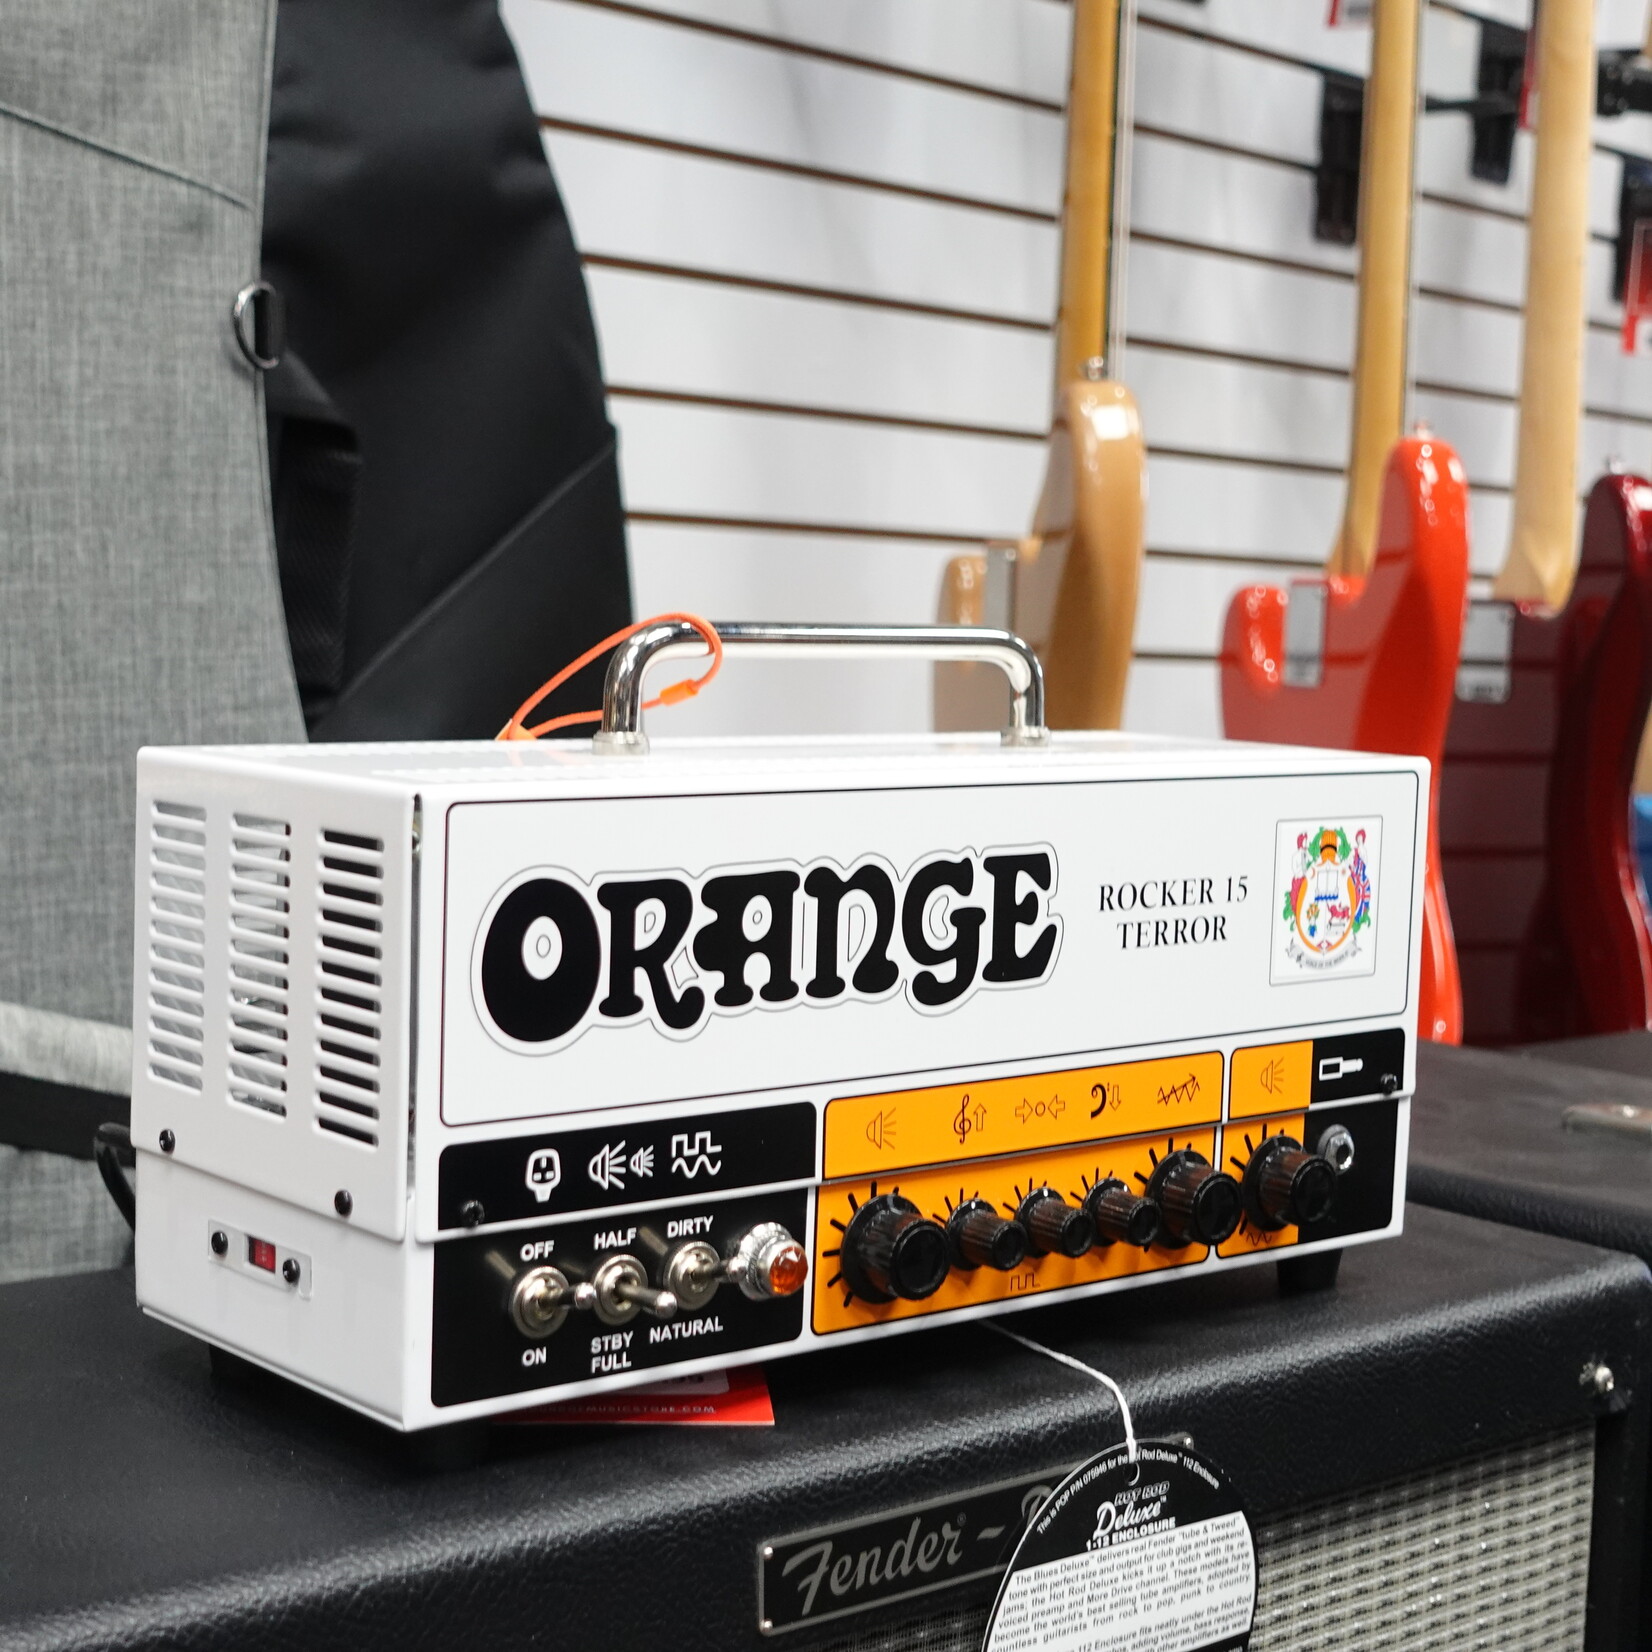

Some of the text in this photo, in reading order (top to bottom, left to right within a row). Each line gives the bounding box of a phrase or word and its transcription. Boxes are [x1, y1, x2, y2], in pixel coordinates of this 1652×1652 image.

[1099, 875, 1248, 912] ROCKER 15
[483, 852, 1057, 1041] ORANGE
[1117, 914, 1227, 950] TERROR
[595, 1227, 637, 1250] HALF
[667, 1215, 714, 1238] DIRTY
[520, 1240, 554, 1261] OFF
[591, 1331, 633, 1354] STBY
[650, 1317, 723, 1344] NATURAL
[522, 1347, 547, 1366] ON
[591, 1353, 631, 1374] FULL
[1037, 1515, 1051, 1534] This
[1049, 1507, 1056, 1518] is
[1055, 1490, 1070, 1511] POP
[1108, 1458, 1116, 1470] for
[1117, 1454, 1128, 1466] the
[1141, 1449, 1155, 1460] Rod
[1183, 1456, 1193, 1470] 112
[1193, 1461, 1219, 1489] Enclosure
[1114, 1481, 1170, 1506] HOT ROD
[1112, 1517, 1176, 1545] ENCLOSURE
[1009, 1528, 1245, 1601] tone with perfect size and output for club gigs and weekend
[1016, 1575, 1031, 1586] The
[1034, 1568, 1058, 1580] Blues
[1097, 1548, 1129, 1563] delivers
[1131, 1542, 1146, 1554] real
[1148, 1536, 1176, 1548] Fender
[1032, 1596, 1045, 1607] the
[1050, 1591, 1065, 1602] Hot
[1069, 1584, 1086, 1596] Rod
[1089, 1576, 1118, 1590] Deluxe
[1122, 1569, 1143, 1581] kicks
[1148, 1565, 1153, 1574] it
[1156, 1562, 1166, 1572] up
[1178, 1553, 1201, 1565] notch
[1205, 1547, 1221, 1558] with
[1225, 1544, 1234, 1553] its
[995, 1626, 1030, 1643] become
[1034, 1622, 1048, 1630] the
[1051, 1611, 1082, 1626] world's
[1087, 1604, 1106, 1617] best
[1110, 1596, 1137, 1609] selling
[1140, 1589, 1158, 1601] tube
[1207, 1565, 1239, 1581] adopted
[1242, 1561, 1250, 1571] by
[999, 1613, 1028, 1629] voiced
[1031, 1604, 1064, 1621] preamp
[1068, 1598, 1083, 1610] and
[1087, 1591, 1108, 1603] More
[1111, 1585, 1132, 1598] Drive
[1174, 1566, 1197, 1577] These
[1200, 1557, 1229, 1570] models
[1231, 1551, 1249, 1562] have
[1044, 1624, 1087, 1643] guitarists
[1093, 1615, 1113, 1628] from
[1119, 1603, 1138, 1619] rock
[1143, 1604, 1151, 1613] to
[1181, 1589, 1201, 1602] punk
[1207, 1584, 1214, 1594] to
[1095, 1631, 1137, 1651] Enclosure
[1140, 1624, 1151, 1635] fits
[1155, 1618, 1179, 1631] neatly
[1181, 1611, 1205, 1623] under
[1207, 1605, 1219, 1615] the
[1221, 1601, 1234, 1610] Hot
[1236, 1594, 1252, 1605] Rod
[1131, 1636, 1158, 1651] adding
[1194, 1620, 1212, 1631] bass
[1157, 1640, 1178, 1652] other
[1181, 1629, 1219, 1648] amplifiers
[1221, 1625, 1229, 1634] as
